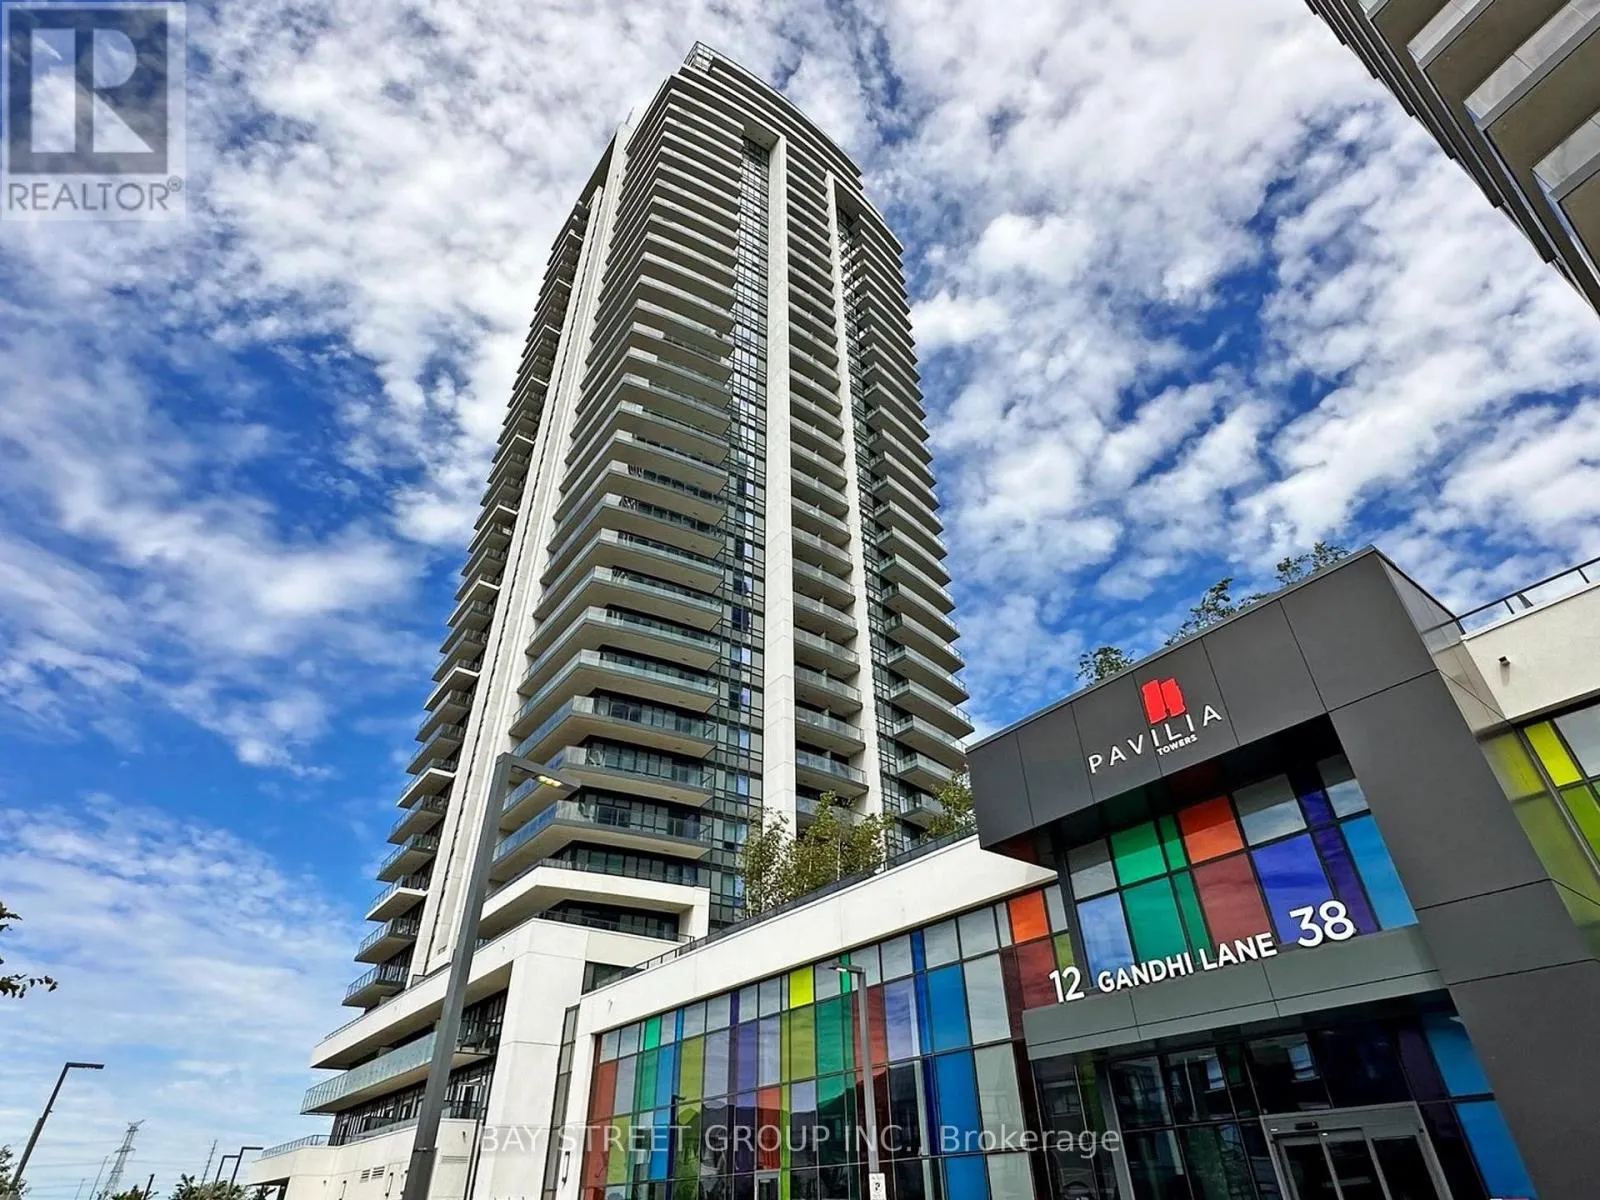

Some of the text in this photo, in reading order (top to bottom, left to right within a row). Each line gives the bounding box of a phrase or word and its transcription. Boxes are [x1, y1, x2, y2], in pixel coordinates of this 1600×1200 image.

[1088, 704, 1222, 773] PAVILIA
[1156, 733, 1198, 756] TOWERS
[1049, 900, 1355, 1004] 12 GANDHI LANE 38
